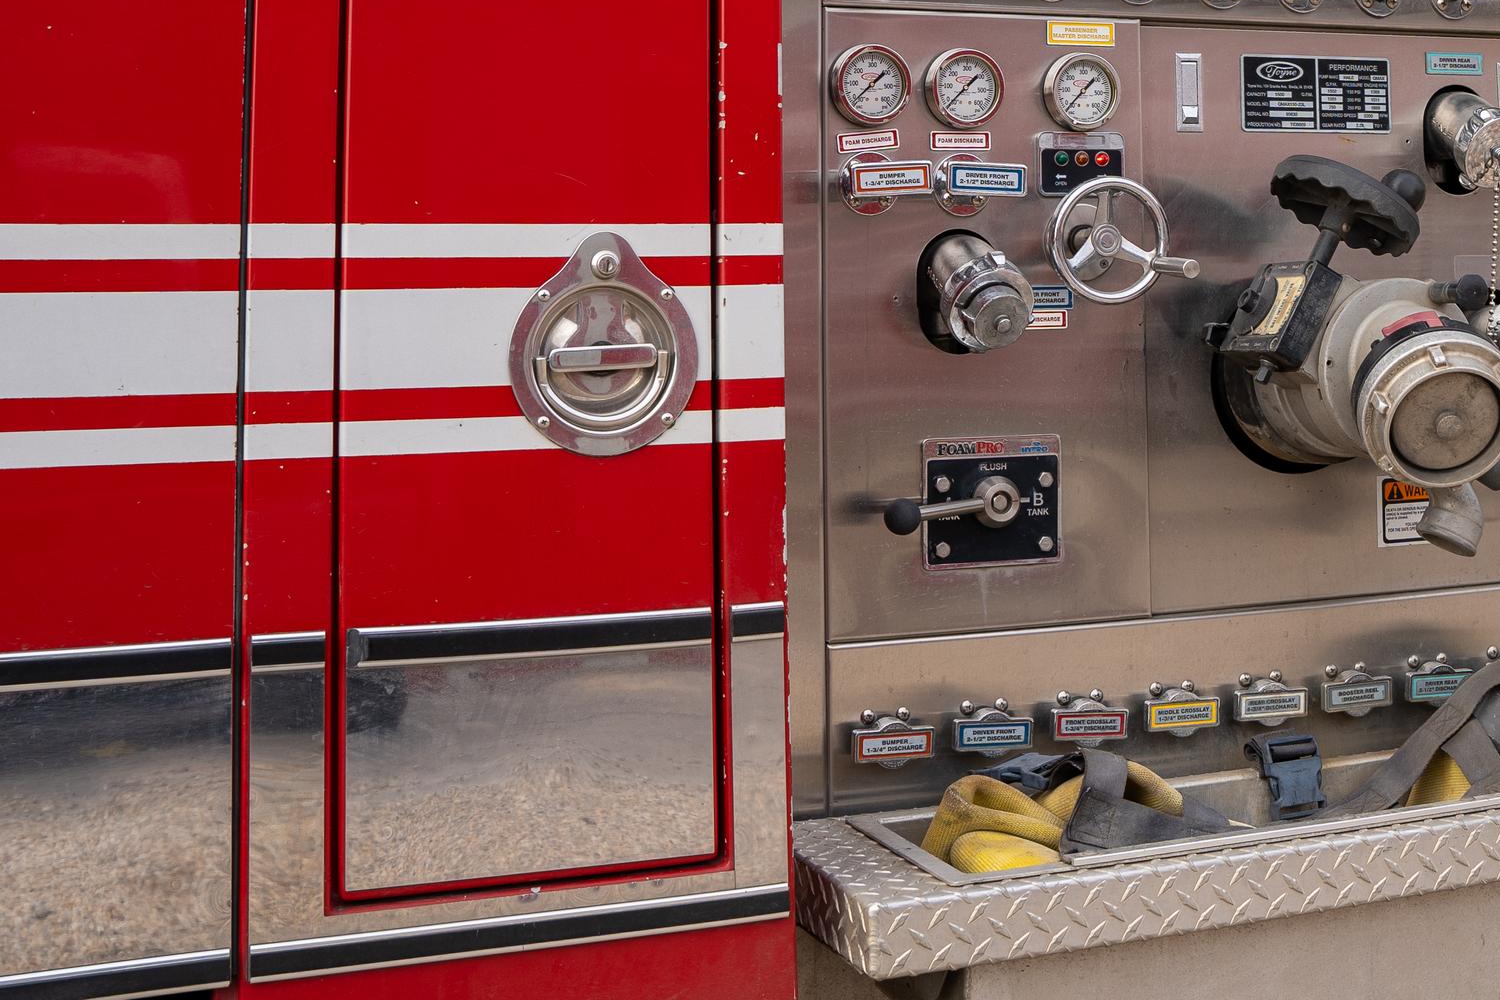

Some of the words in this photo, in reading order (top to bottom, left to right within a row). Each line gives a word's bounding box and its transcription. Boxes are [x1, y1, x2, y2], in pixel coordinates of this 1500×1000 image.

[1265, 65, 1297, 78] Toyne
[1329, 64, 1378, 72] PERFORMANCE
[937, 442, 1004, 456] FOAMPRO
[980, 463, 1007, 471] FLUSH
[1033, 492, 1044, 506] B
[1027, 508, 1049, 516] TANK
